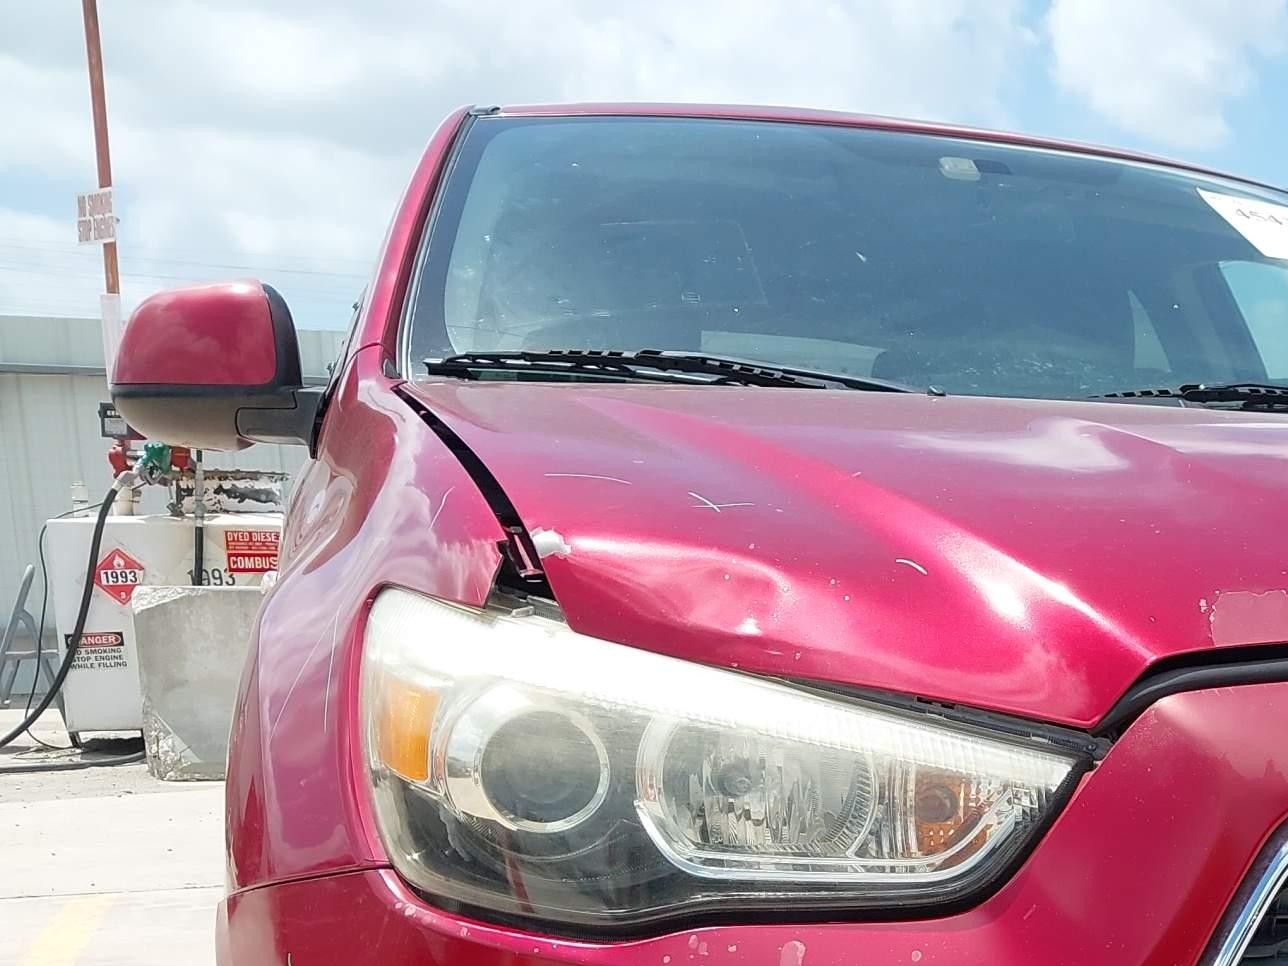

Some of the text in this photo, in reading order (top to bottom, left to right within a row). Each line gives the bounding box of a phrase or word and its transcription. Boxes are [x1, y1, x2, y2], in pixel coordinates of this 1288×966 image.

[227, 532, 279, 542] DYED DIESE
[230, 557, 278, 569] COMBUS
[103, 570, 138, 584] 1993
[79, 635, 116, 645] ANGER
[85, 647, 122, 655] SMOKING
[95, 654, 124, 662] ENGINE
